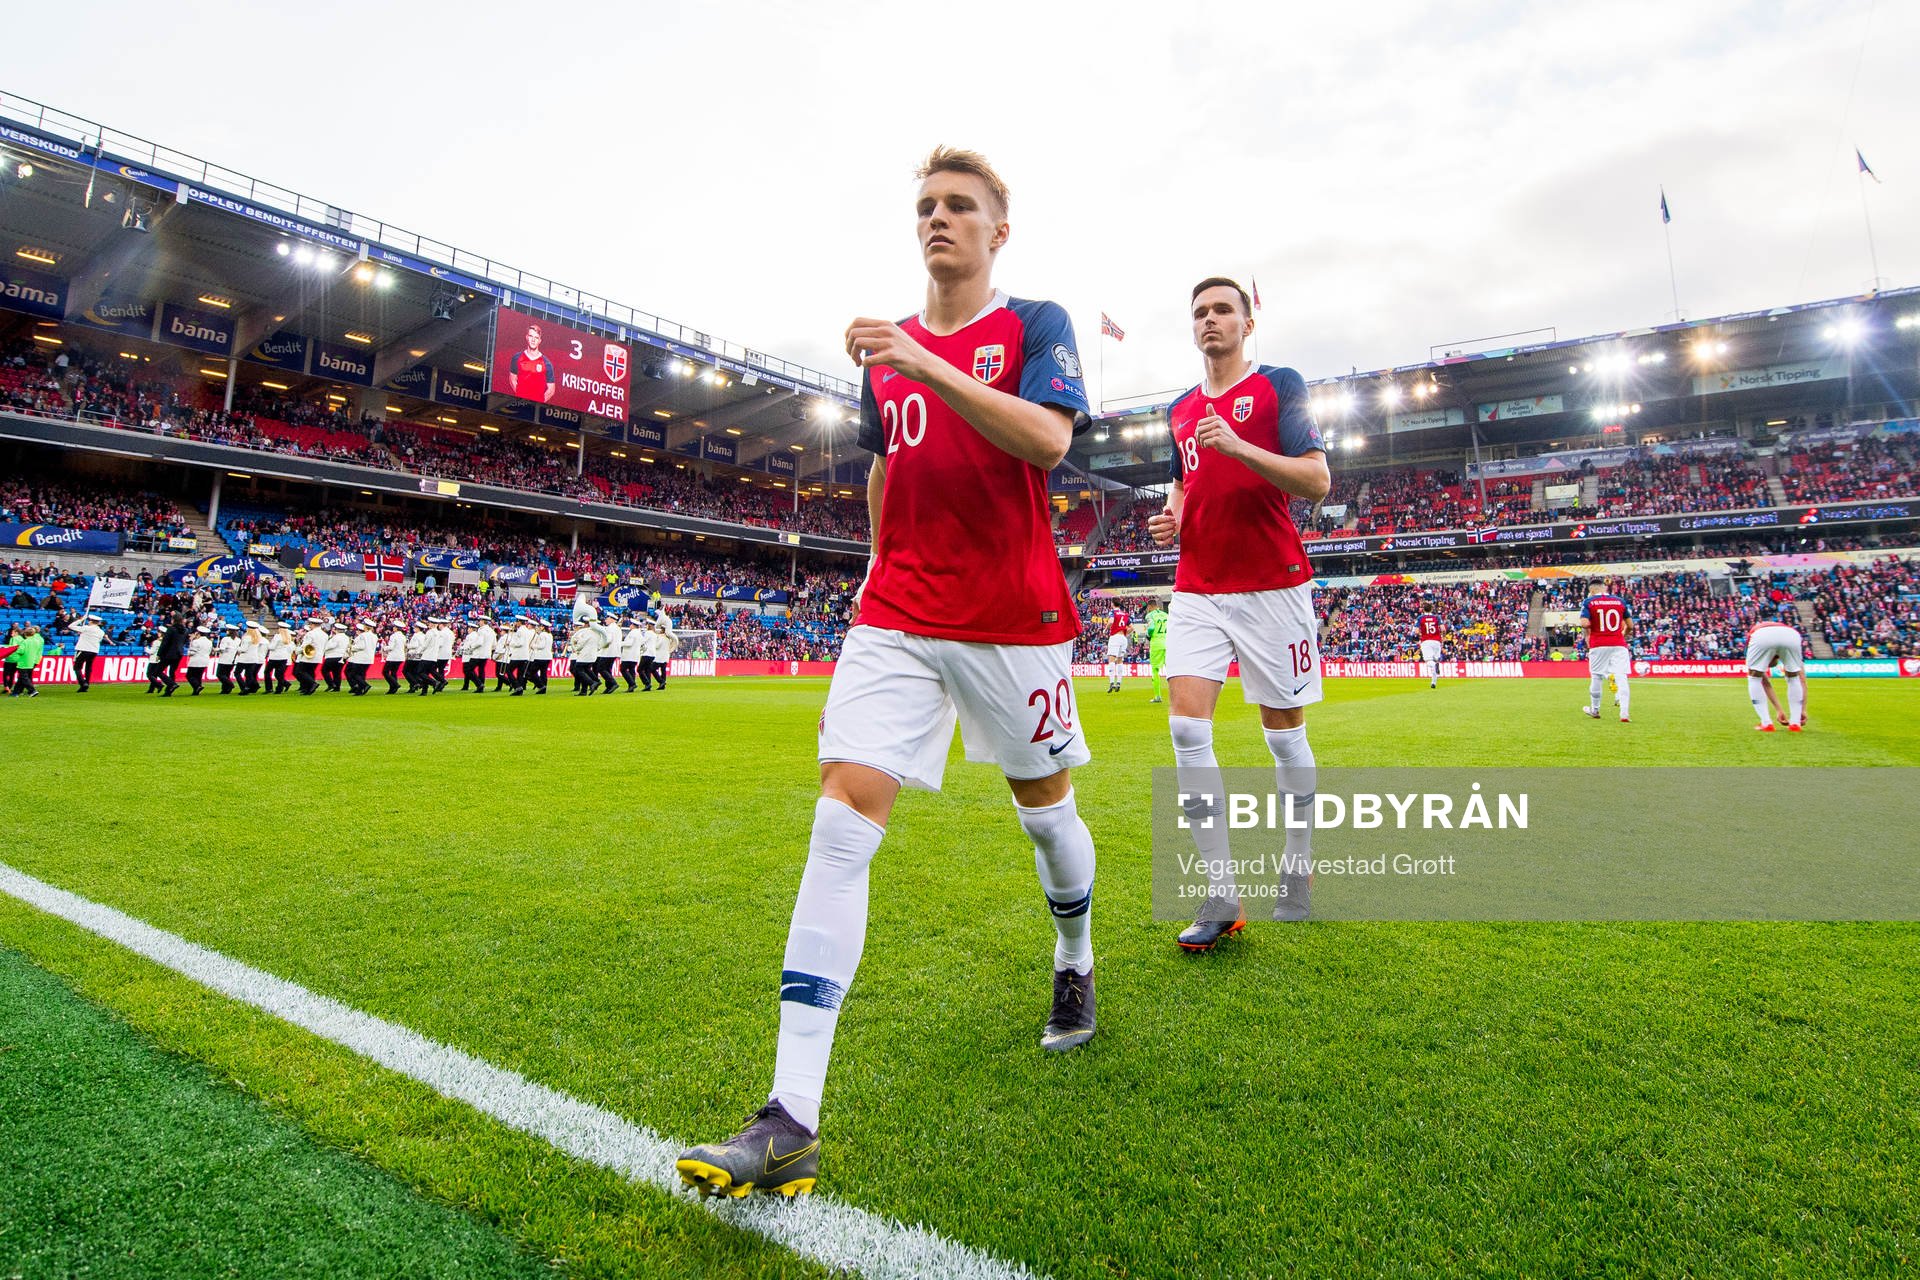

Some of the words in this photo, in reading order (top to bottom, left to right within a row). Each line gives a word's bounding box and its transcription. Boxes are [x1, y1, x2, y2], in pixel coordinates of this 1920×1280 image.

[188, 188, 244, 212] OPPLEV
[245, 207, 358, 249] BENDIT-EFFEKTEN
[100, 304, 147, 318] Bendit
[171, 317, 229, 344] bama
[264, 341, 302, 355] Bendit
[569, 340, 583, 360] 3
[320, 352, 367, 375] bama
[1740, 374, 1773, 384] Norsk
[1775, 369, 1821, 381] Tipping
[443, 380, 482, 401] bama
[562, 373, 625, 401] KRISTOFFER
[587, 400, 624, 419] AJER
[884, 393, 927, 454] 20
[633, 424, 661, 441] bama
[707, 442, 733, 457] bama
[1178, 437, 1199, 474] 18
[771, 456, 794, 470] bama
[1588, 525, 1620, 534] Norsk
[1621, 523, 1661, 535] Tipping
[36, 529, 83, 545] Bendit
[1395, 538, 1420, 547] Norsk
[1421, 536, 1456, 547] Tipping
[213, 558, 255, 575] Bendit
[323, 552, 357, 568] Bendit
[1097, 558, 1117, 567] Norsk
[1117, 557, 1141, 567] Tipping
[500, 568, 526, 580] Bendit
[723, 587, 740, 598] Bendit
[760, 589, 776, 600] Bendit
[1119, 616, 1125, 627] 6
[1596, 608, 1620, 632] 10
[1425, 622, 1436, 634] 15
[1288, 639, 1312, 677] 18
[1325, 663, 1416, 677] EM-KVALIFISERING
[1652, 665, 1706, 673] EUROPEAN
[1804, 663, 1829, 674] EFA
[1831, 663, 1863, 673] EURO
[1863, 663, 1895, 673] 2020
[1028, 678, 1072, 743] 20
